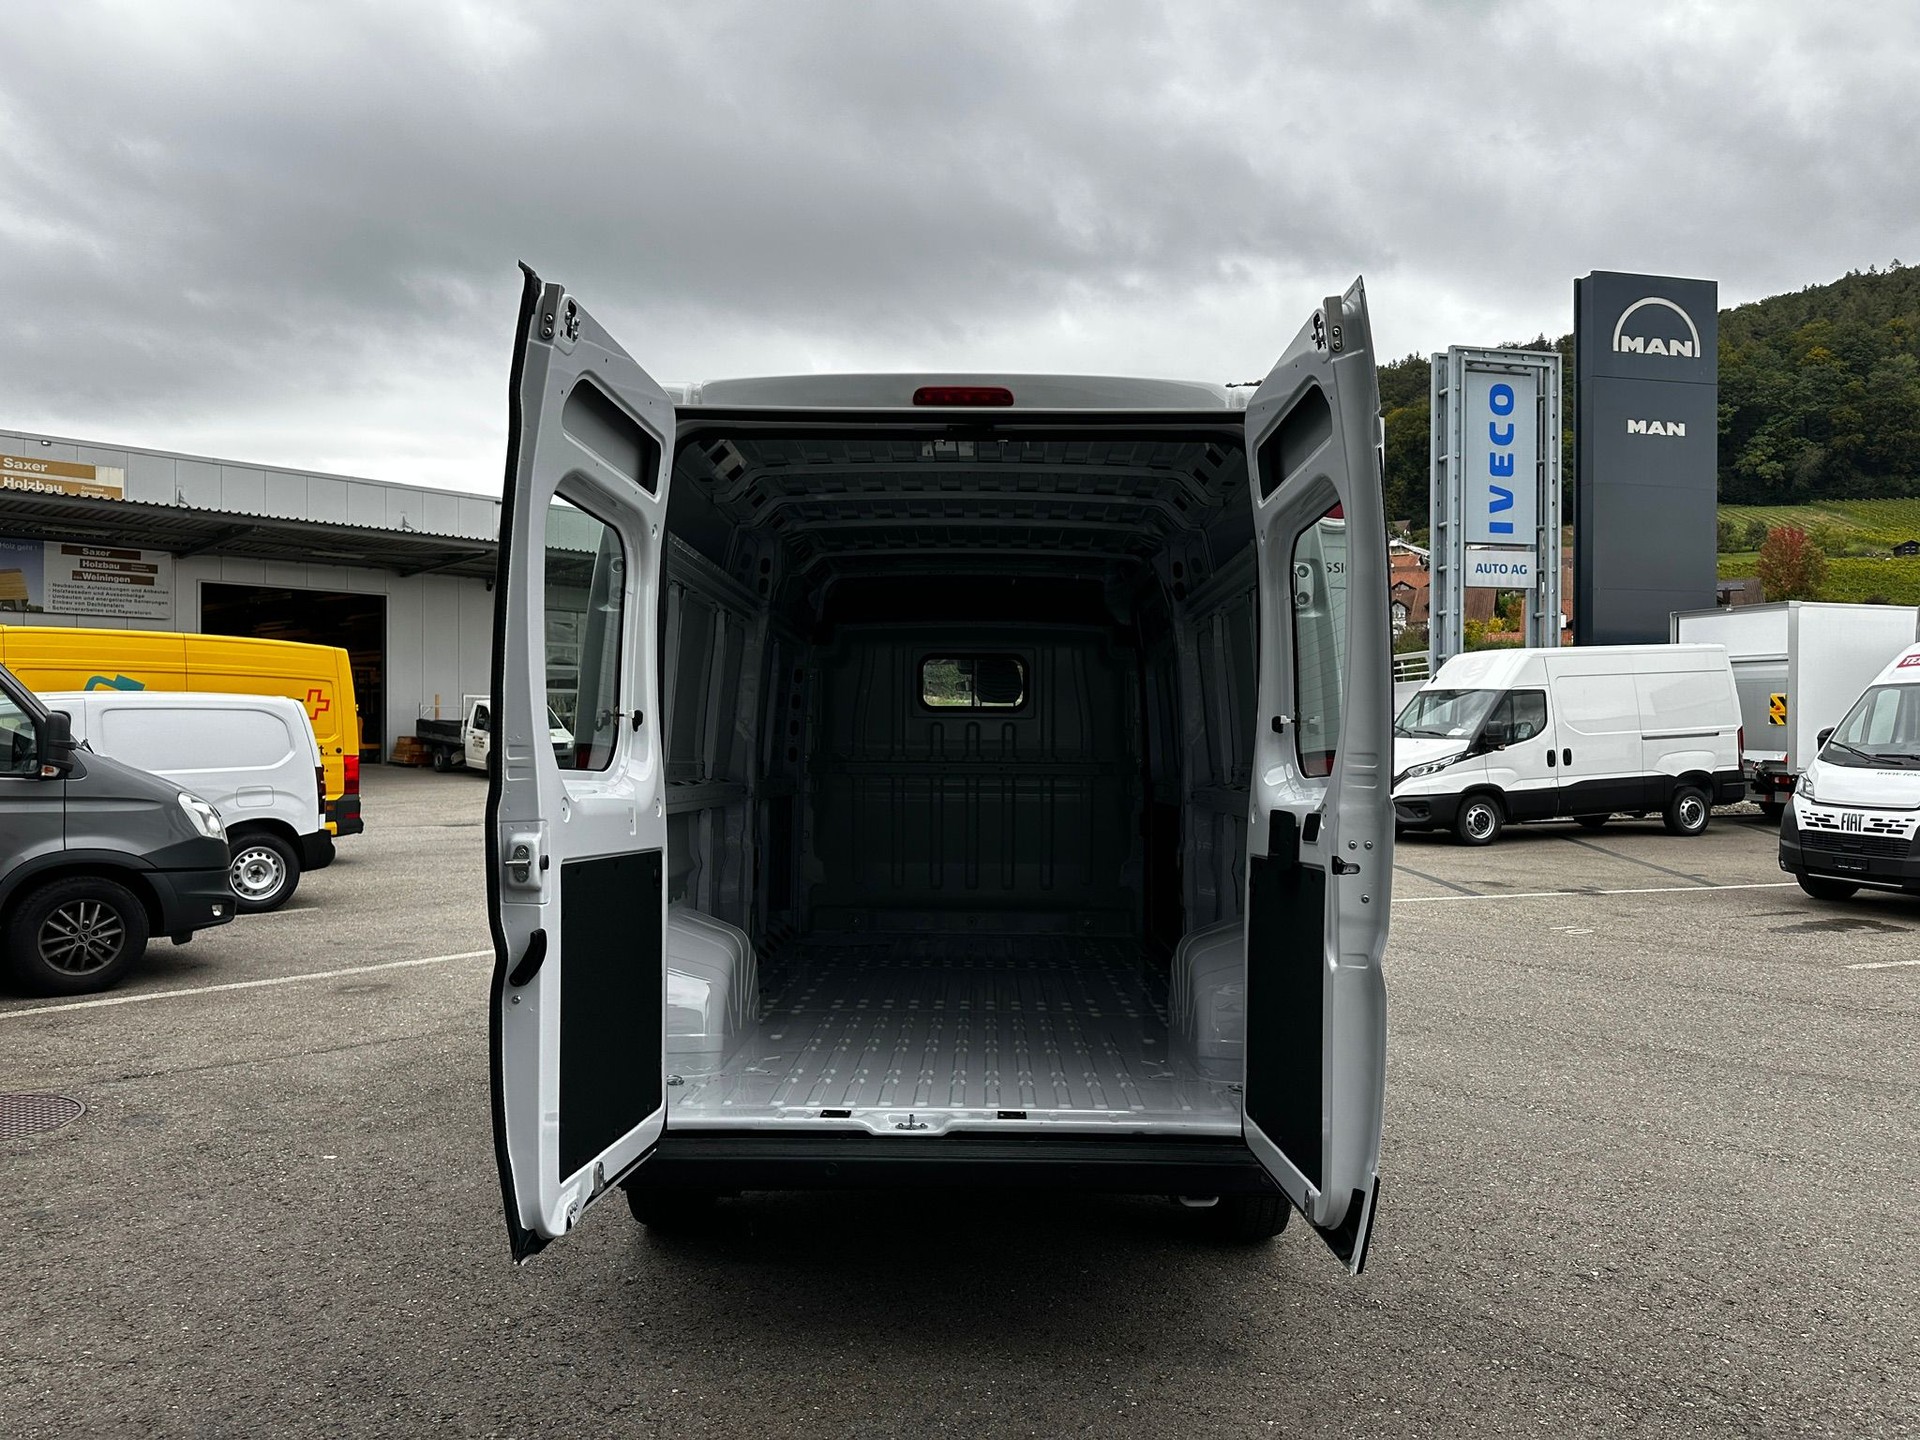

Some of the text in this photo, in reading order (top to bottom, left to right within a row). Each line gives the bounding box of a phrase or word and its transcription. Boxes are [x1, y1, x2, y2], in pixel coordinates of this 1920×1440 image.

[1621, 335, 1693, 358] MAN
[1627, 419, 1686, 437] MAN
[3, 457, 48, 472] Saxer
[1489, 383, 1514, 534] IVECO
[3, 476, 63, 493] Holzbau
[82, 547, 111, 557] Saxer
[82, 560, 120, 570] Holzbau
[1326, 562, 1345, 574] SSI
[1475, 563, 1528, 575] AUTO AG
[82, 572, 131, 583] Weiningen
[1841, 812, 1865, 832] FIAT
